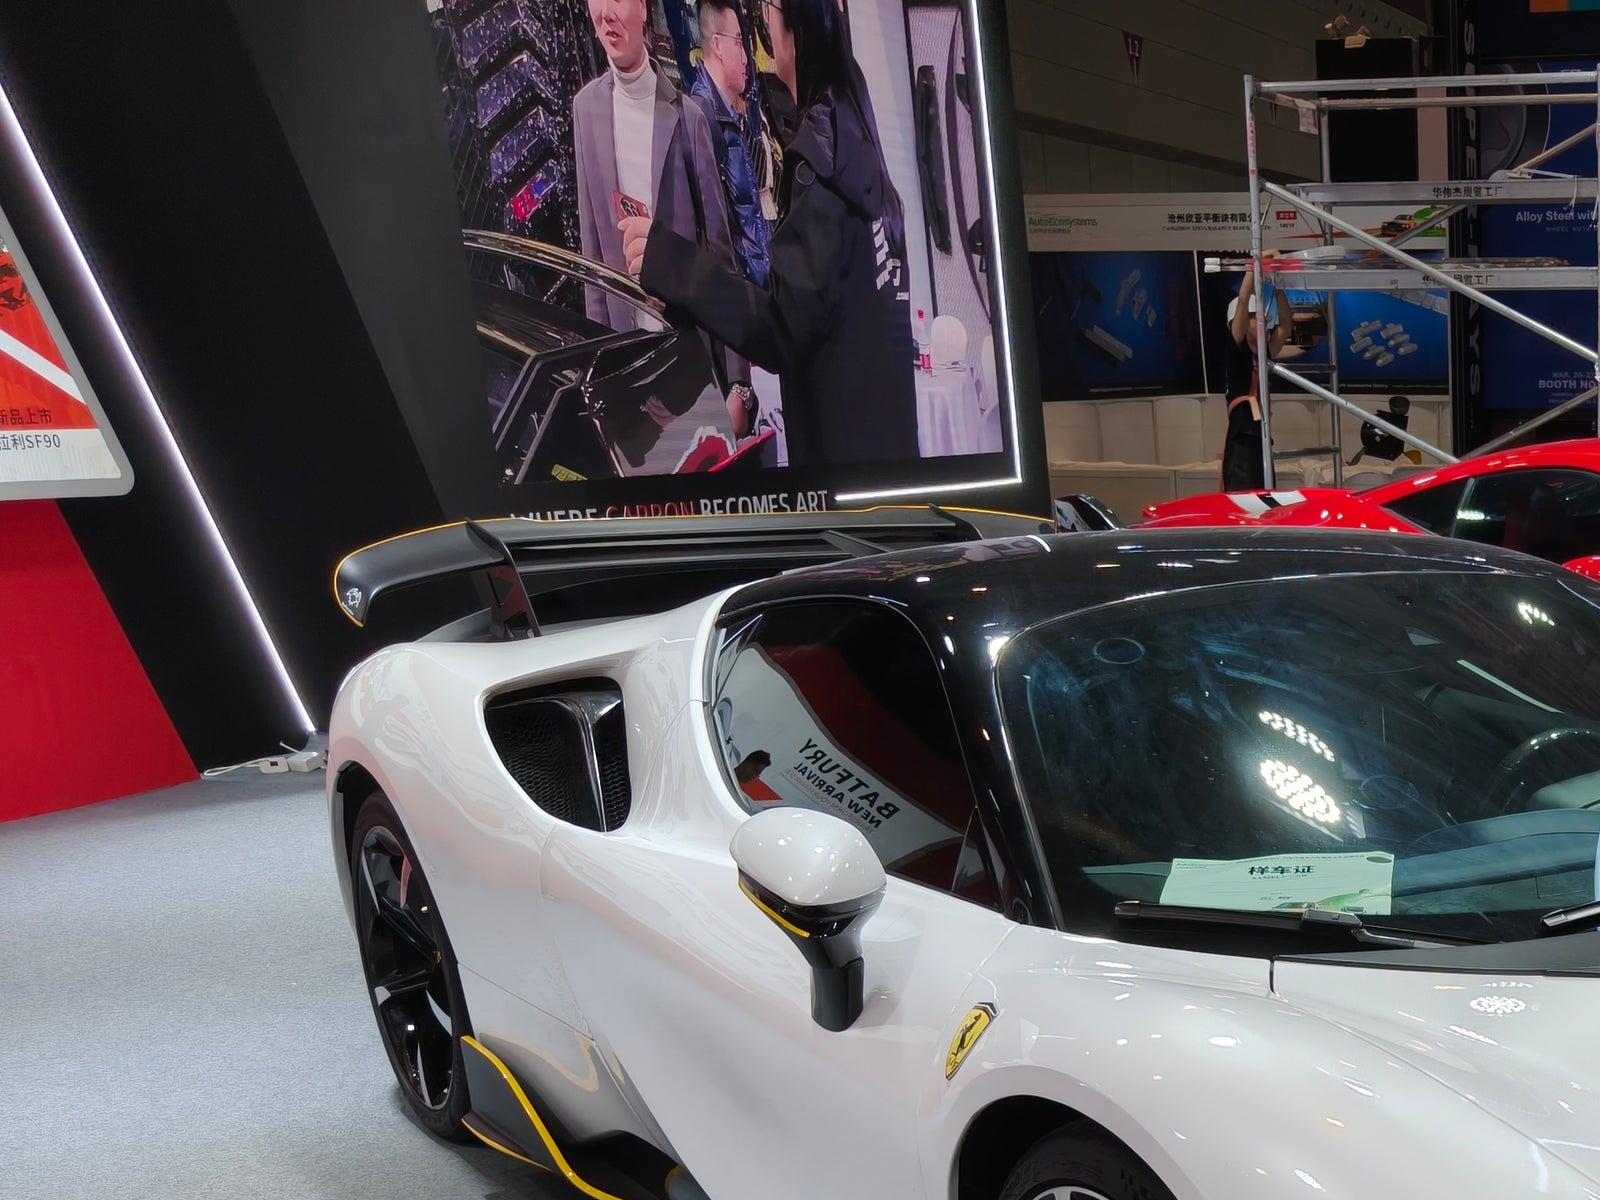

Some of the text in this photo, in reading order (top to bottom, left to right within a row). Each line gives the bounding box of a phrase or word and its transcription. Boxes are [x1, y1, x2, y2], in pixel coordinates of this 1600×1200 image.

[1515, 211, 1544, 224] Alloy
[1538, 380, 1577, 389] BOOTH
[796, 490, 828, 512] ART
[1248, 865, 1316, 876] 样车证
